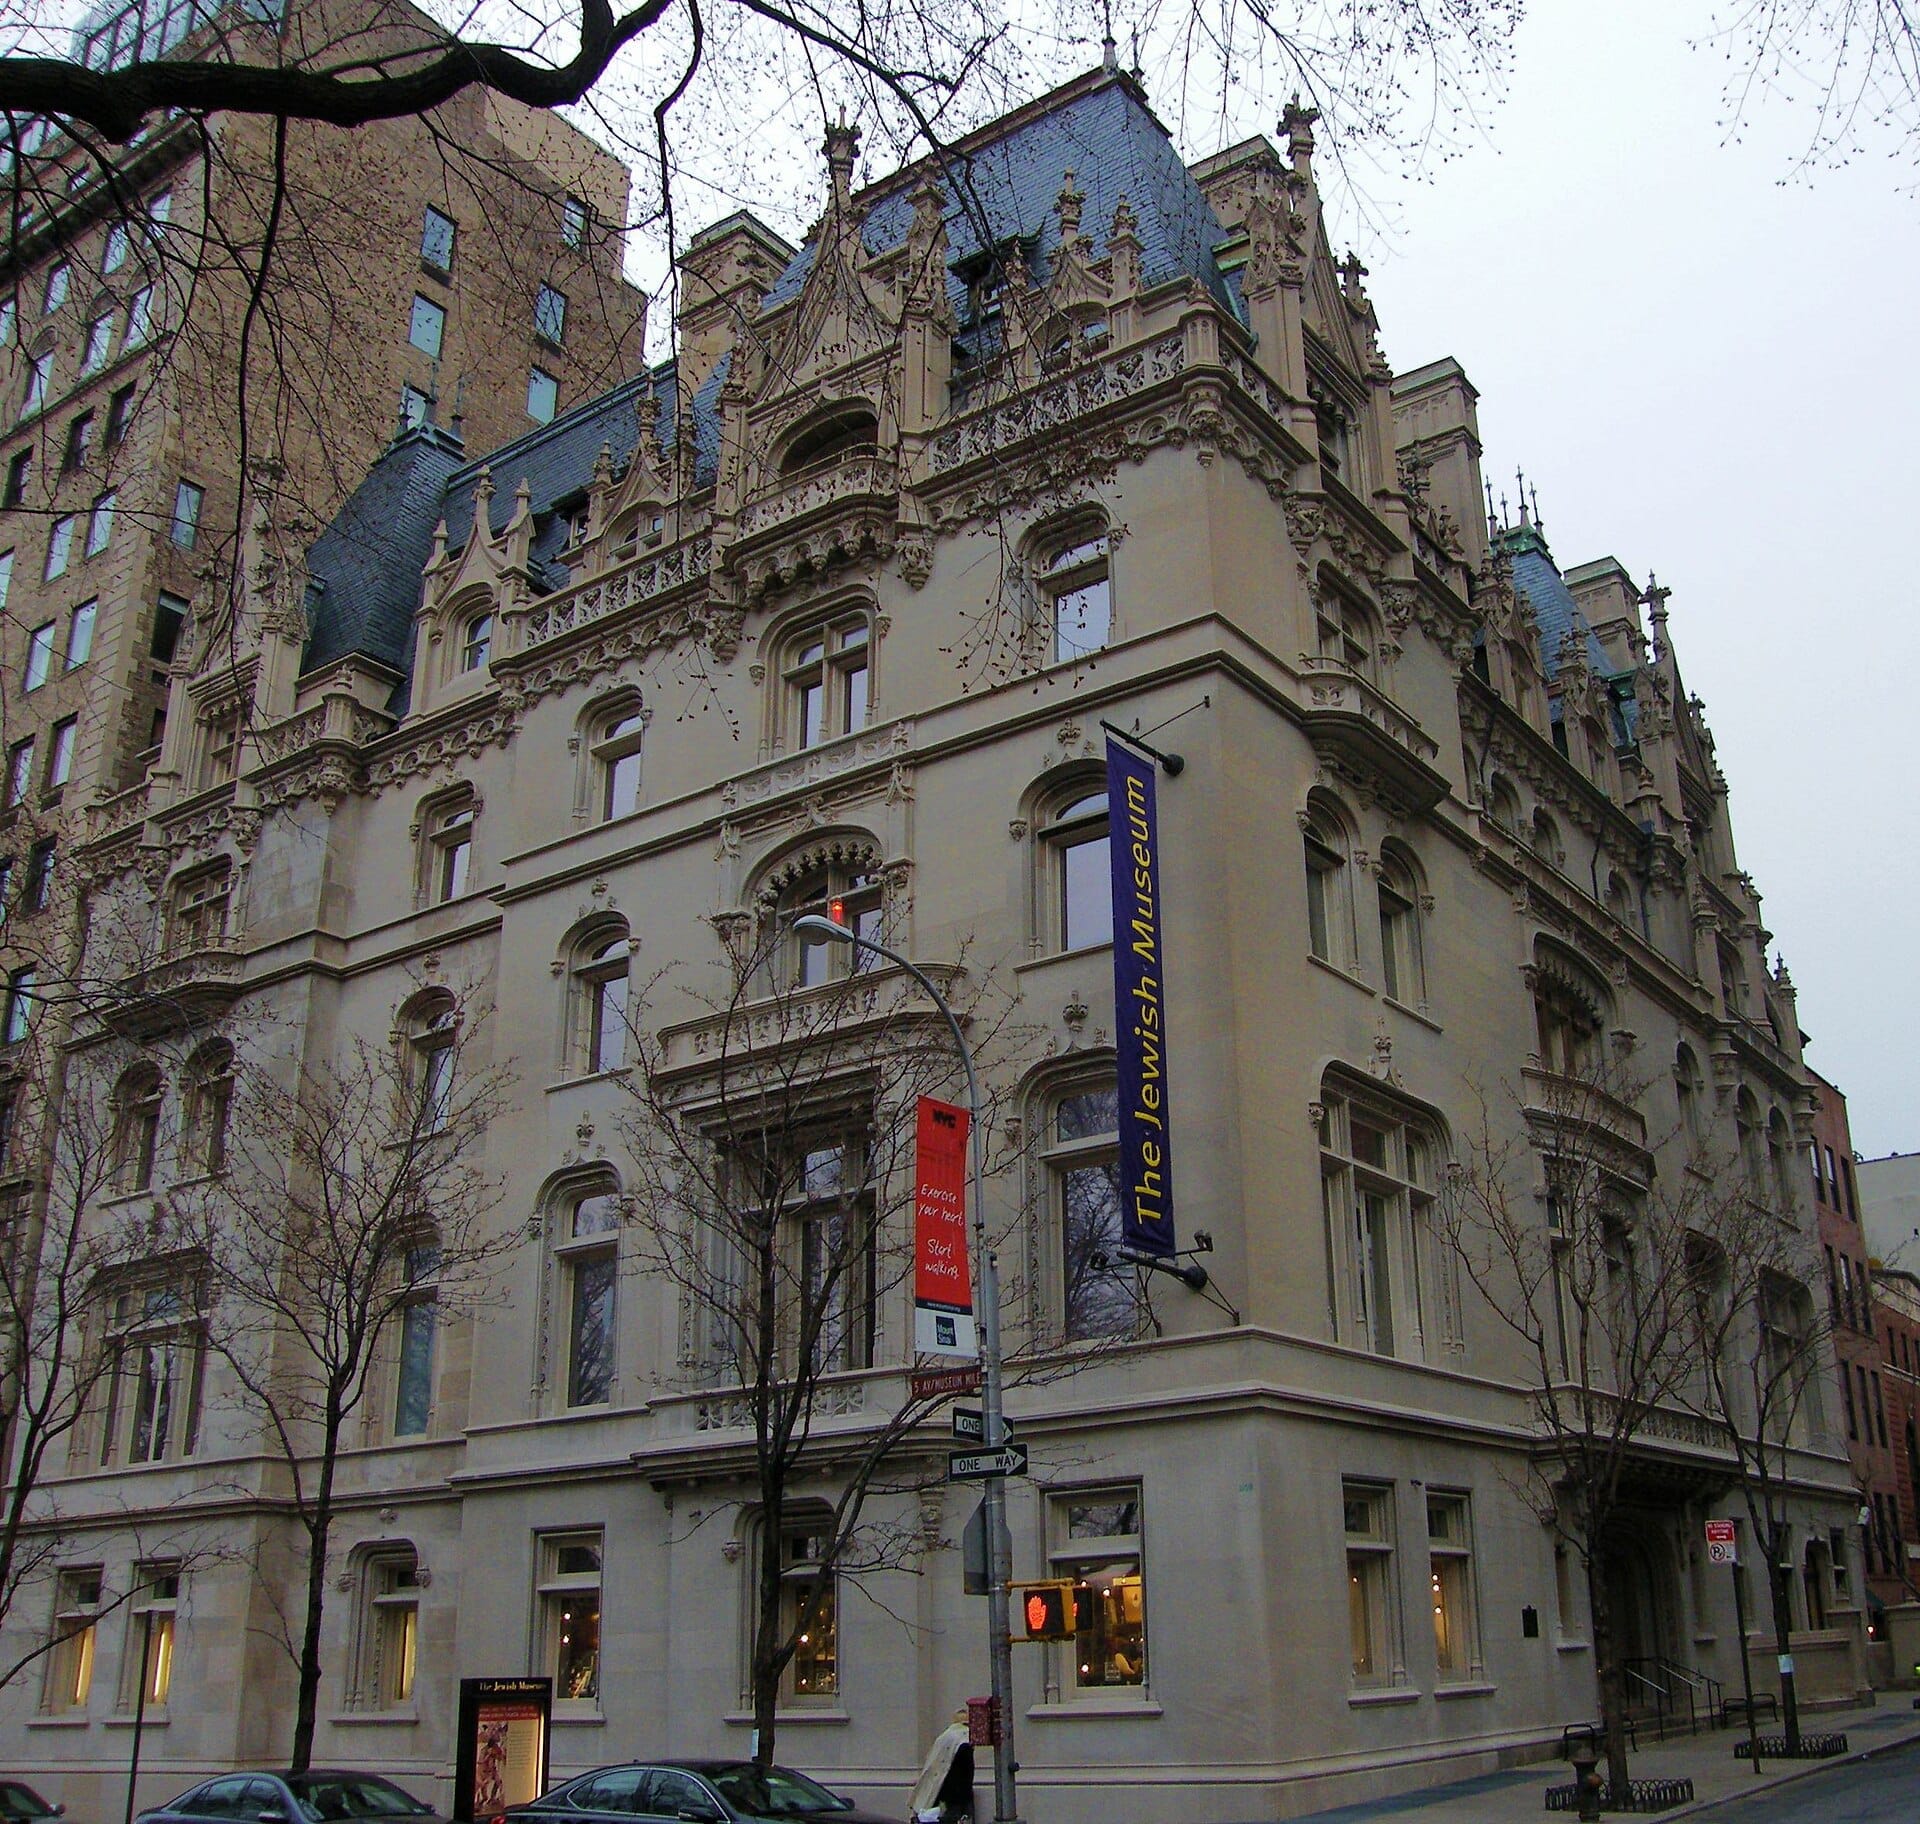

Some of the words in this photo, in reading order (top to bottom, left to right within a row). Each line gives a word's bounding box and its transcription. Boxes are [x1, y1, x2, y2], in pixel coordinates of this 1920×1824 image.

[1126, 774, 1156, 964] Museum
[1132, 976, 1162, 1129] Jewish
[1134, 1140, 1163, 1222] The
[921, 1184, 957, 1204] Exercise
[927, 1239, 952, 1259] Start
[961, 1418, 981, 1432] ONE
[959, 1459, 981, 1472] ONE
[994, 1454, 1018, 1468] WAY
